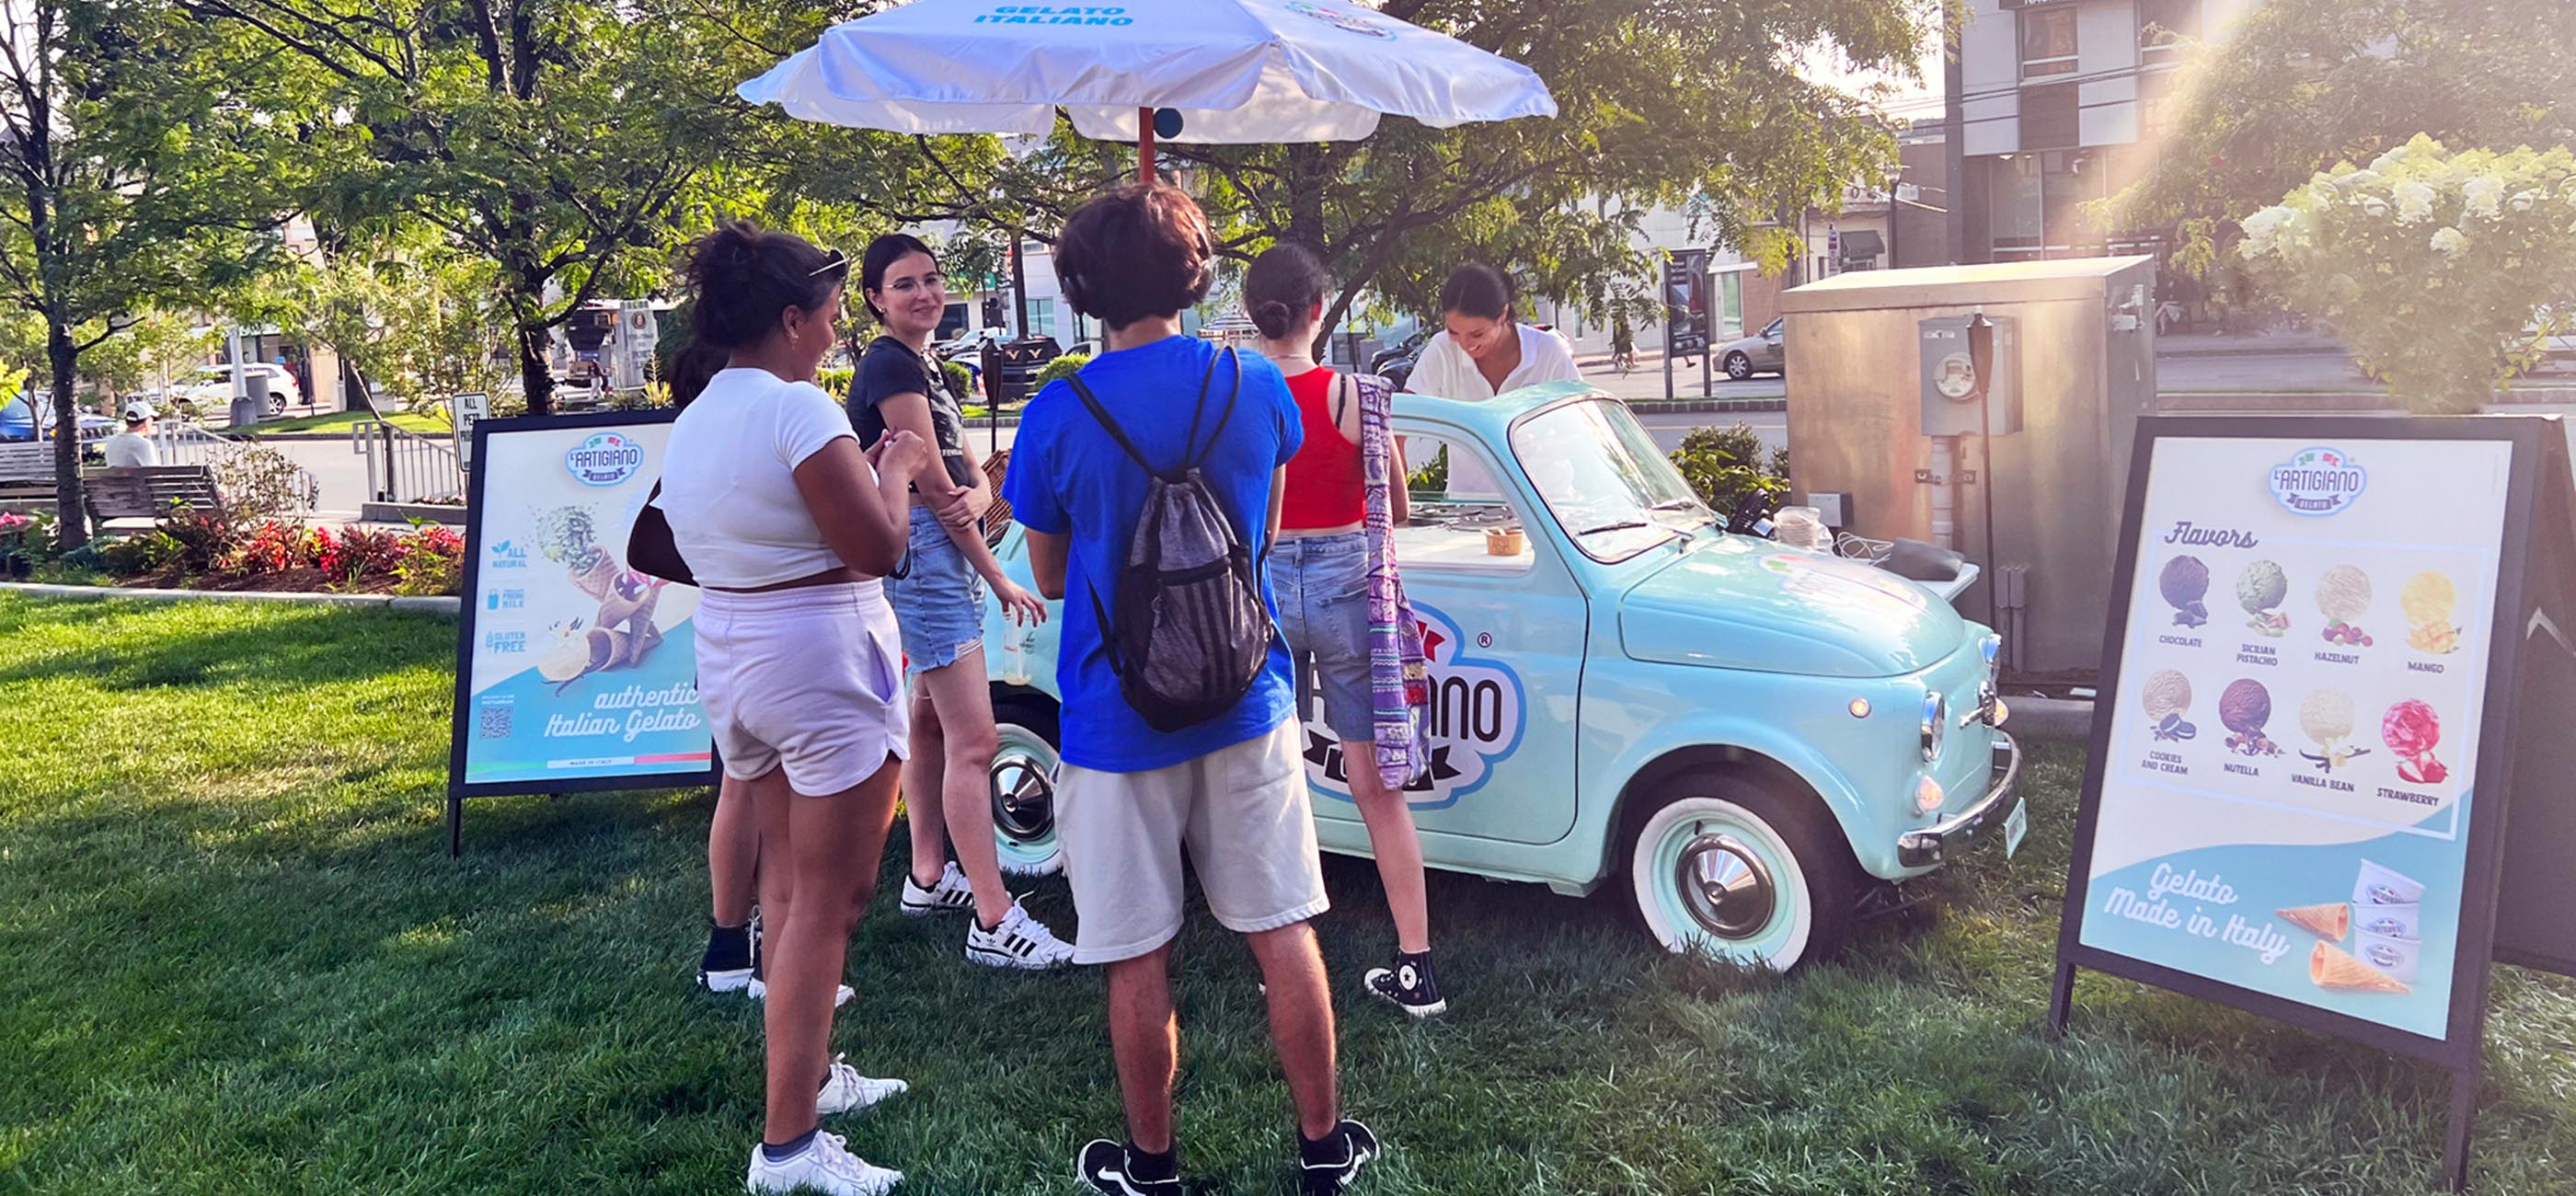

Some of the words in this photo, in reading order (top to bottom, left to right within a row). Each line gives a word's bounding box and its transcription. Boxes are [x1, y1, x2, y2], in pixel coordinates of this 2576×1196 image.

[995, 6, 1125, 16] GELATO
[973, 15, 1134, 27] ITALIANO
[464, 397, 477, 409] ALL
[570, 448, 638, 467] L'ARTIGIANO
[2274, 469, 2359, 491] L'ARTIGIANO
[2165, 521, 2259, 548] Flavors
[507, 546, 527, 558] ALL
[492, 559, 527, 568] NATURAL
[494, 641, 525, 653] FREE
[2158, 635, 2202, 648] CHOCOLATE
[2241, 644, 2276, 656] SICILIAN
[2237, 654, 2278, 667] PISTACHIO
[2314, 651, 2359, 664] HAZELNUT
[2407, 661, 2444, 673] MANGO
[593, 684, 699, 709] authentic
[545, 712, 620, 737] Italian
[623, 707, 700, 742] Gelato
[2150, 751, 2182, 764] COOKIES
[2141, 760, 2158, 770] AND
[2160, 763, 2188, 775] CREAM
[2224, 763, 2260, 776] NUTELLA
[2292, 774, 2327, 788] VANILLA
[2329, 779, 2354, 792] BEAN
[2376, 788, 2439, 806] STRAWBERRY
[2147, 862, 2238, 905] Gelato
[2103, 886, 2181, 929] Made
[2186, 905, 2218, 938] in
[2222, 913, 2290, 965] Italy
